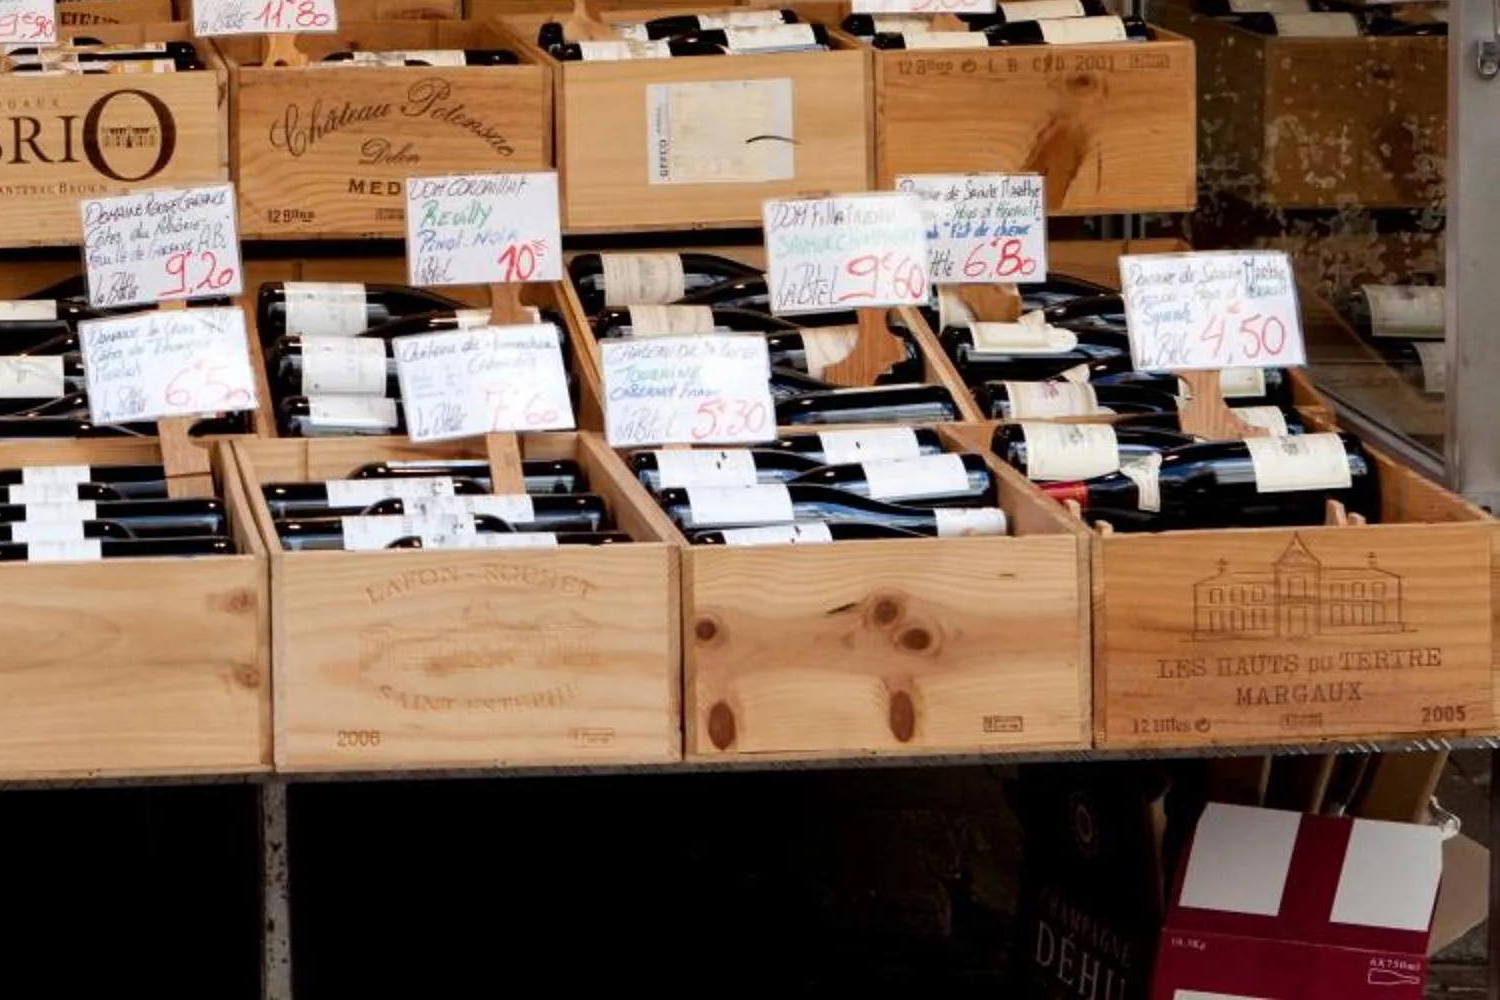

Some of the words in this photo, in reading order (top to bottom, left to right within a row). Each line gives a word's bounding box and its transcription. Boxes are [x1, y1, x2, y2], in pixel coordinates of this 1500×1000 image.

[347, 178, 401, 196] MED
[1155, 657, 1208, 681] LES
[1215, 653, 1299, 679] HAUTS
[1337, 646, 1443, 673] TERTRE
[1234, 680, 1365, 708] MARGAUX
[1420, 704, 1468, 724] 2005
